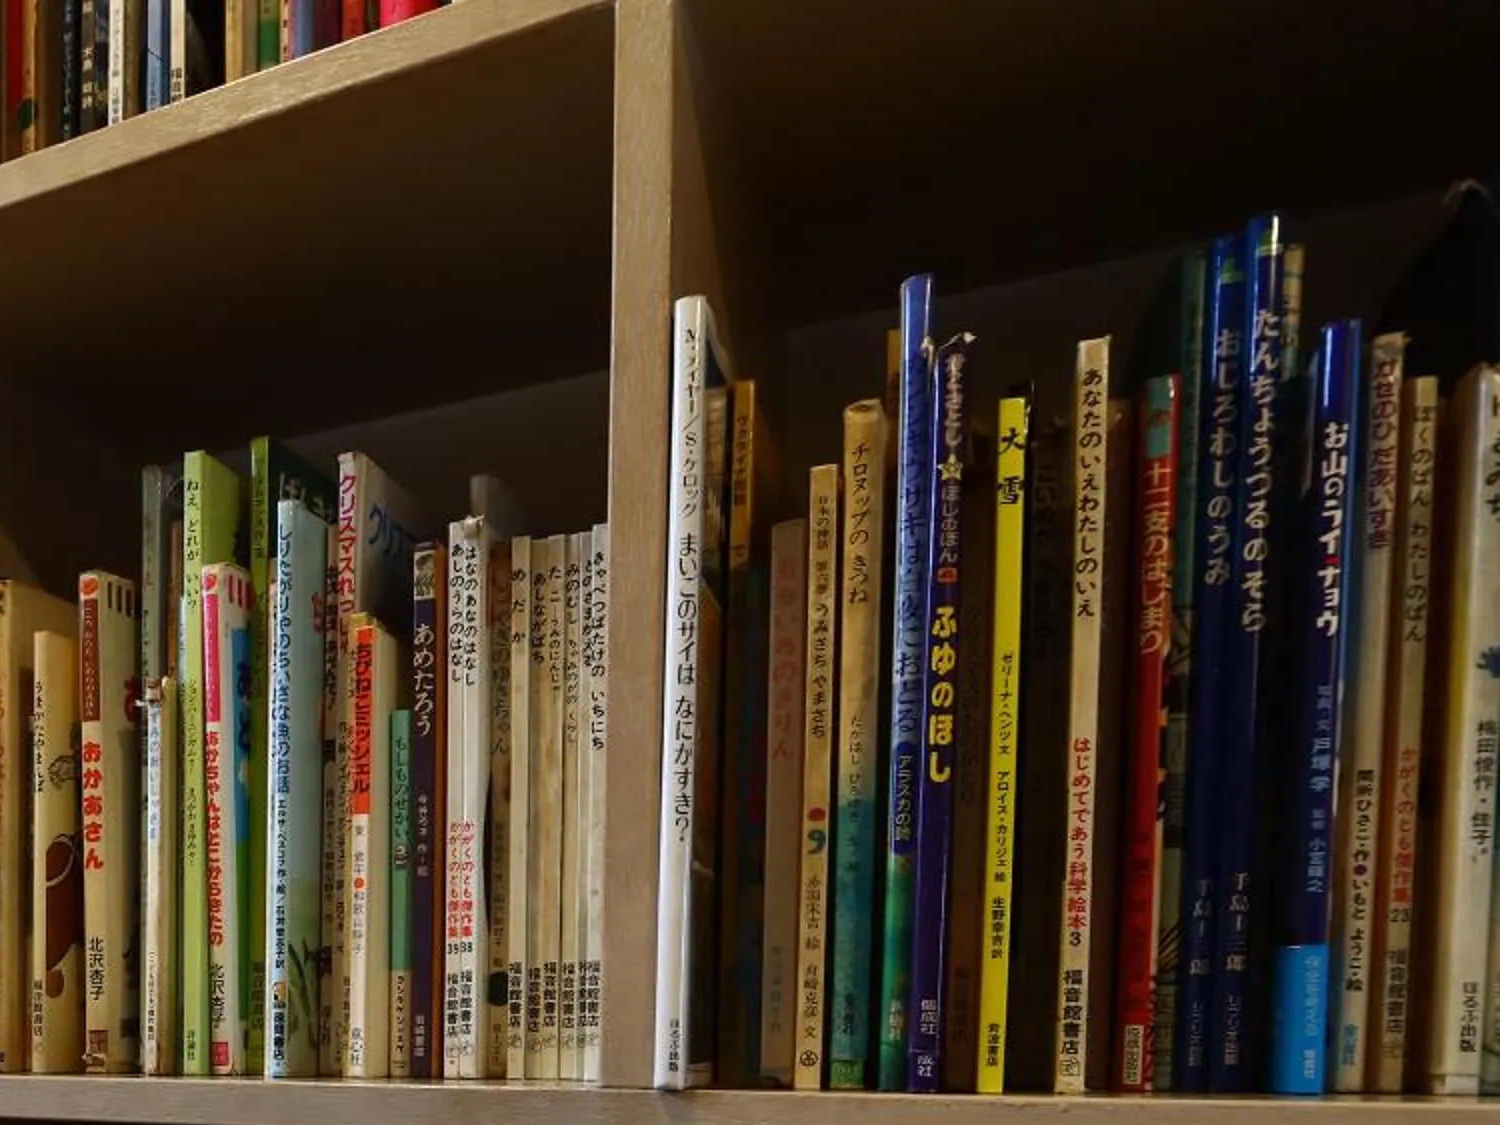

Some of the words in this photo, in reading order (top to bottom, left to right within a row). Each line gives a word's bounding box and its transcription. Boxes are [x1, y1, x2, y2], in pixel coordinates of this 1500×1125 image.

[998, 428, 1026, 505] 大雪
[1075, 368, 1102, 618] あなたのいえわたしのいえ
[186, 521, 200, 561] どれが
[1140, 463, 1171, 655] 十二支のはじまり
[1316, 421, 1349, 637] お山のライチョウ
[450, 544, 464, 683] あしのうらのはなし
[464, 546, 479, 687] はなのあなのはなし
[511, 569, 527, 644] めだか
[530, 572, 547, 666] あしながばち
[677, 533, 698, 685] まいごのサイは
[413, 625, 436, 737] あめたろう
[591, 690, 607, 751] いちにち
[811, 602, 830, 740] うみさちやまさち
[928, 606, 957, 784] ふゆのほし
[83, 741, 104, 870] おかあさん
[392, 734, 411, 842] もしものせかい
[1067, 737, 1092, 930] はじめてであう科学絵本
[204, 731, 224, 949] あかちゃんはどこからくるの
[447, 823, 461, 938] かがくのとも傑作集
[460, 820, 475, 938] かがくのとも傑作集
[88, 936, 105, 1001] 北沢杏子
[1068, 931, 1082, 947] 3
[446, 972, 460, 1038] 福音館書店
[459, 971, 473, 1036] 福音館書店
[509, 961, 523, 1029] 福音館書店
[527, 967, 542, 1033] 福音館書店
[543, 961, 558, 1028] 福音館書店
[561, 962, 576, 1029] 福音館書店
[587, 960, 601, 1028] 福音館書店
[1059, 969, 1083, 1056] 福音館書店
